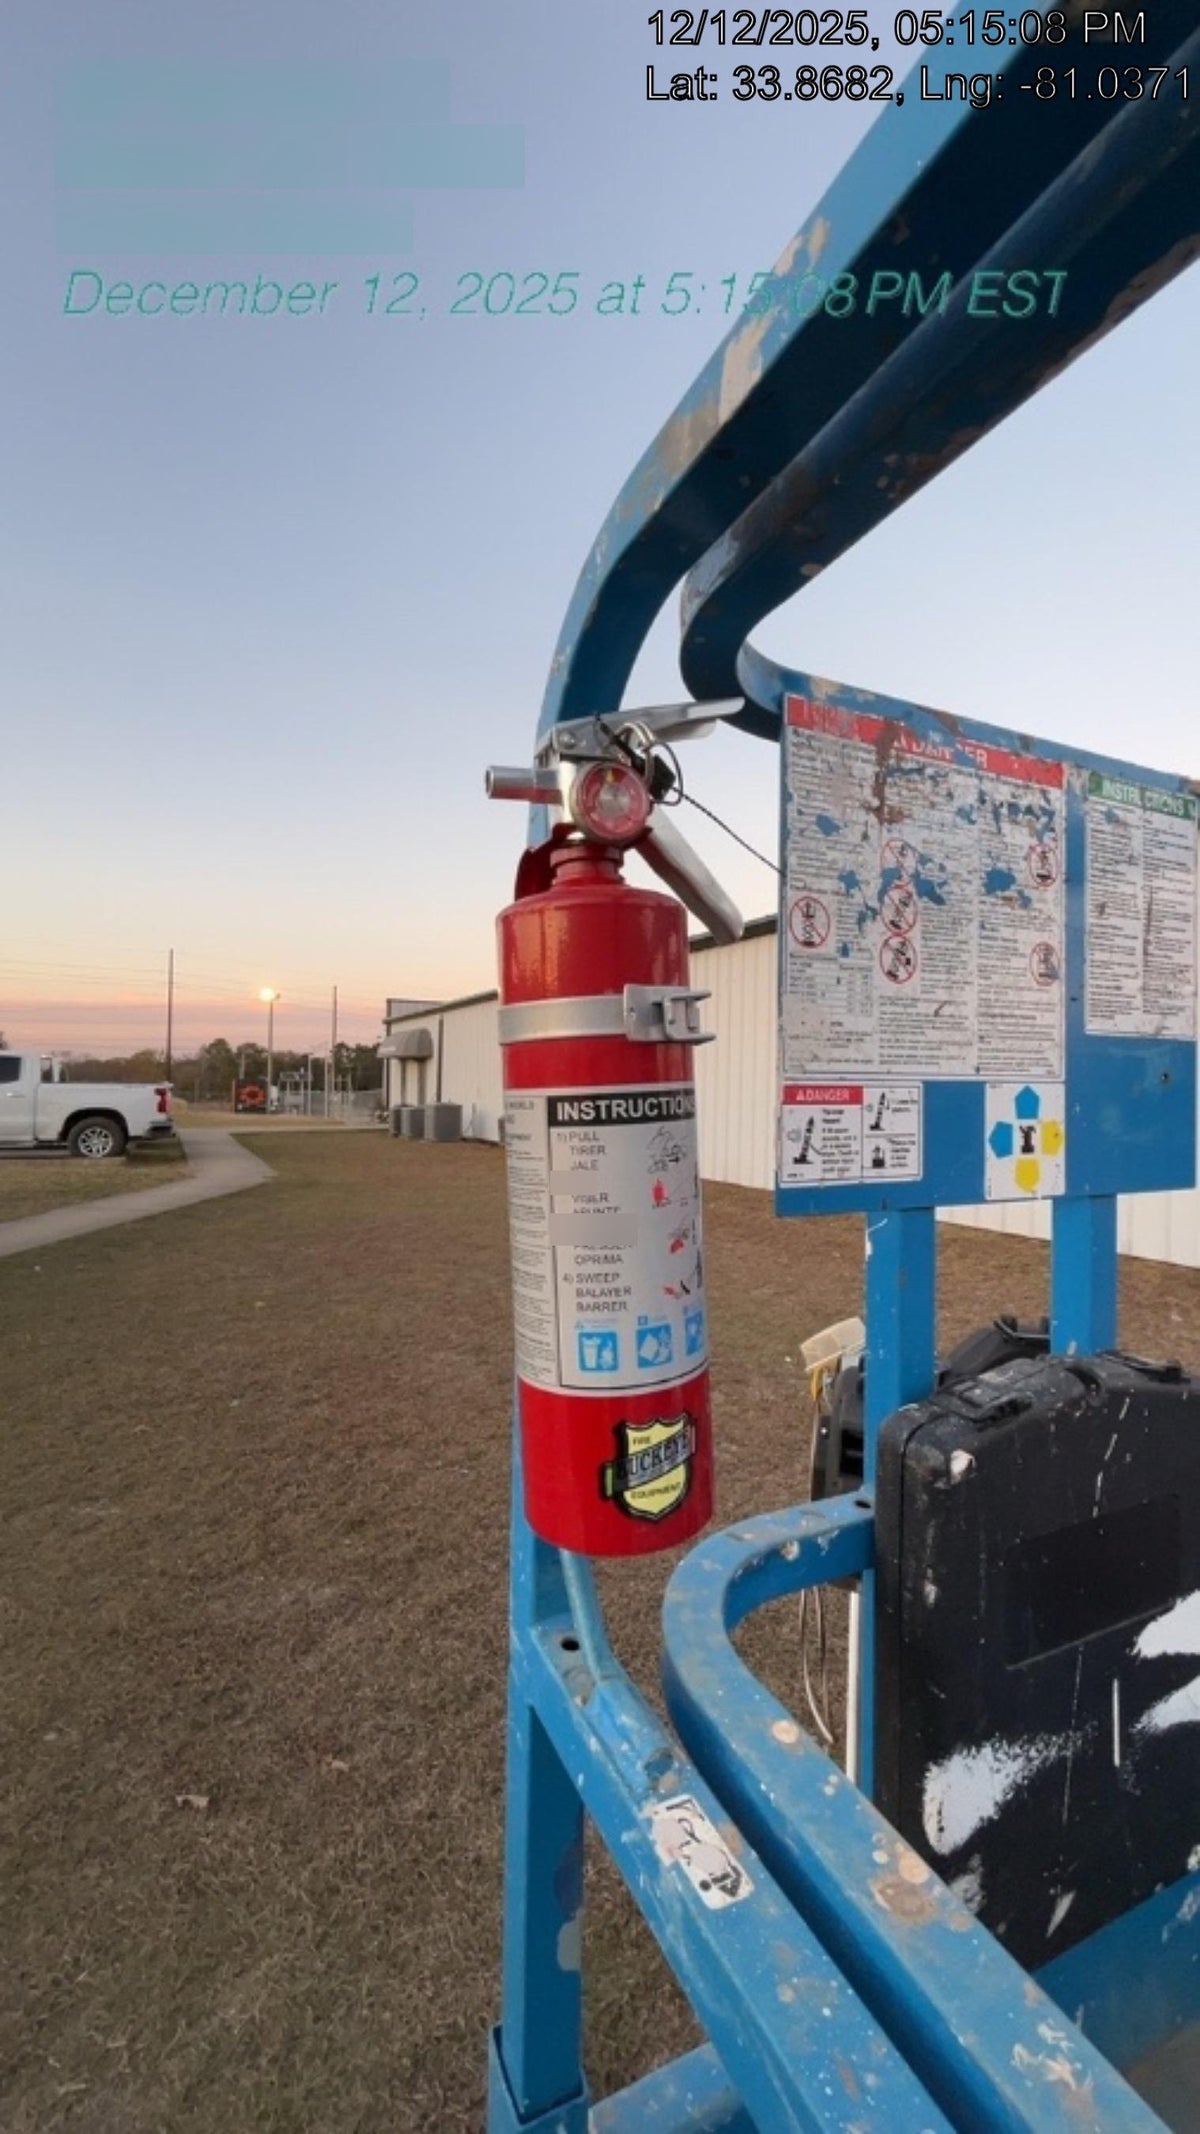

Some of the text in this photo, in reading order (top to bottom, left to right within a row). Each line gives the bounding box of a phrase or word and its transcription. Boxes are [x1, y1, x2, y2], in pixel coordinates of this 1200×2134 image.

[806, 1087, 849, 1101] DANGER
[569, 1130, 600, 1142] PULL
[575, 1272, 620, 1284] SWEEP
[575, 1286, 632, 1299] BALAYER
[576, 1301, 628, 1312] BARRER
